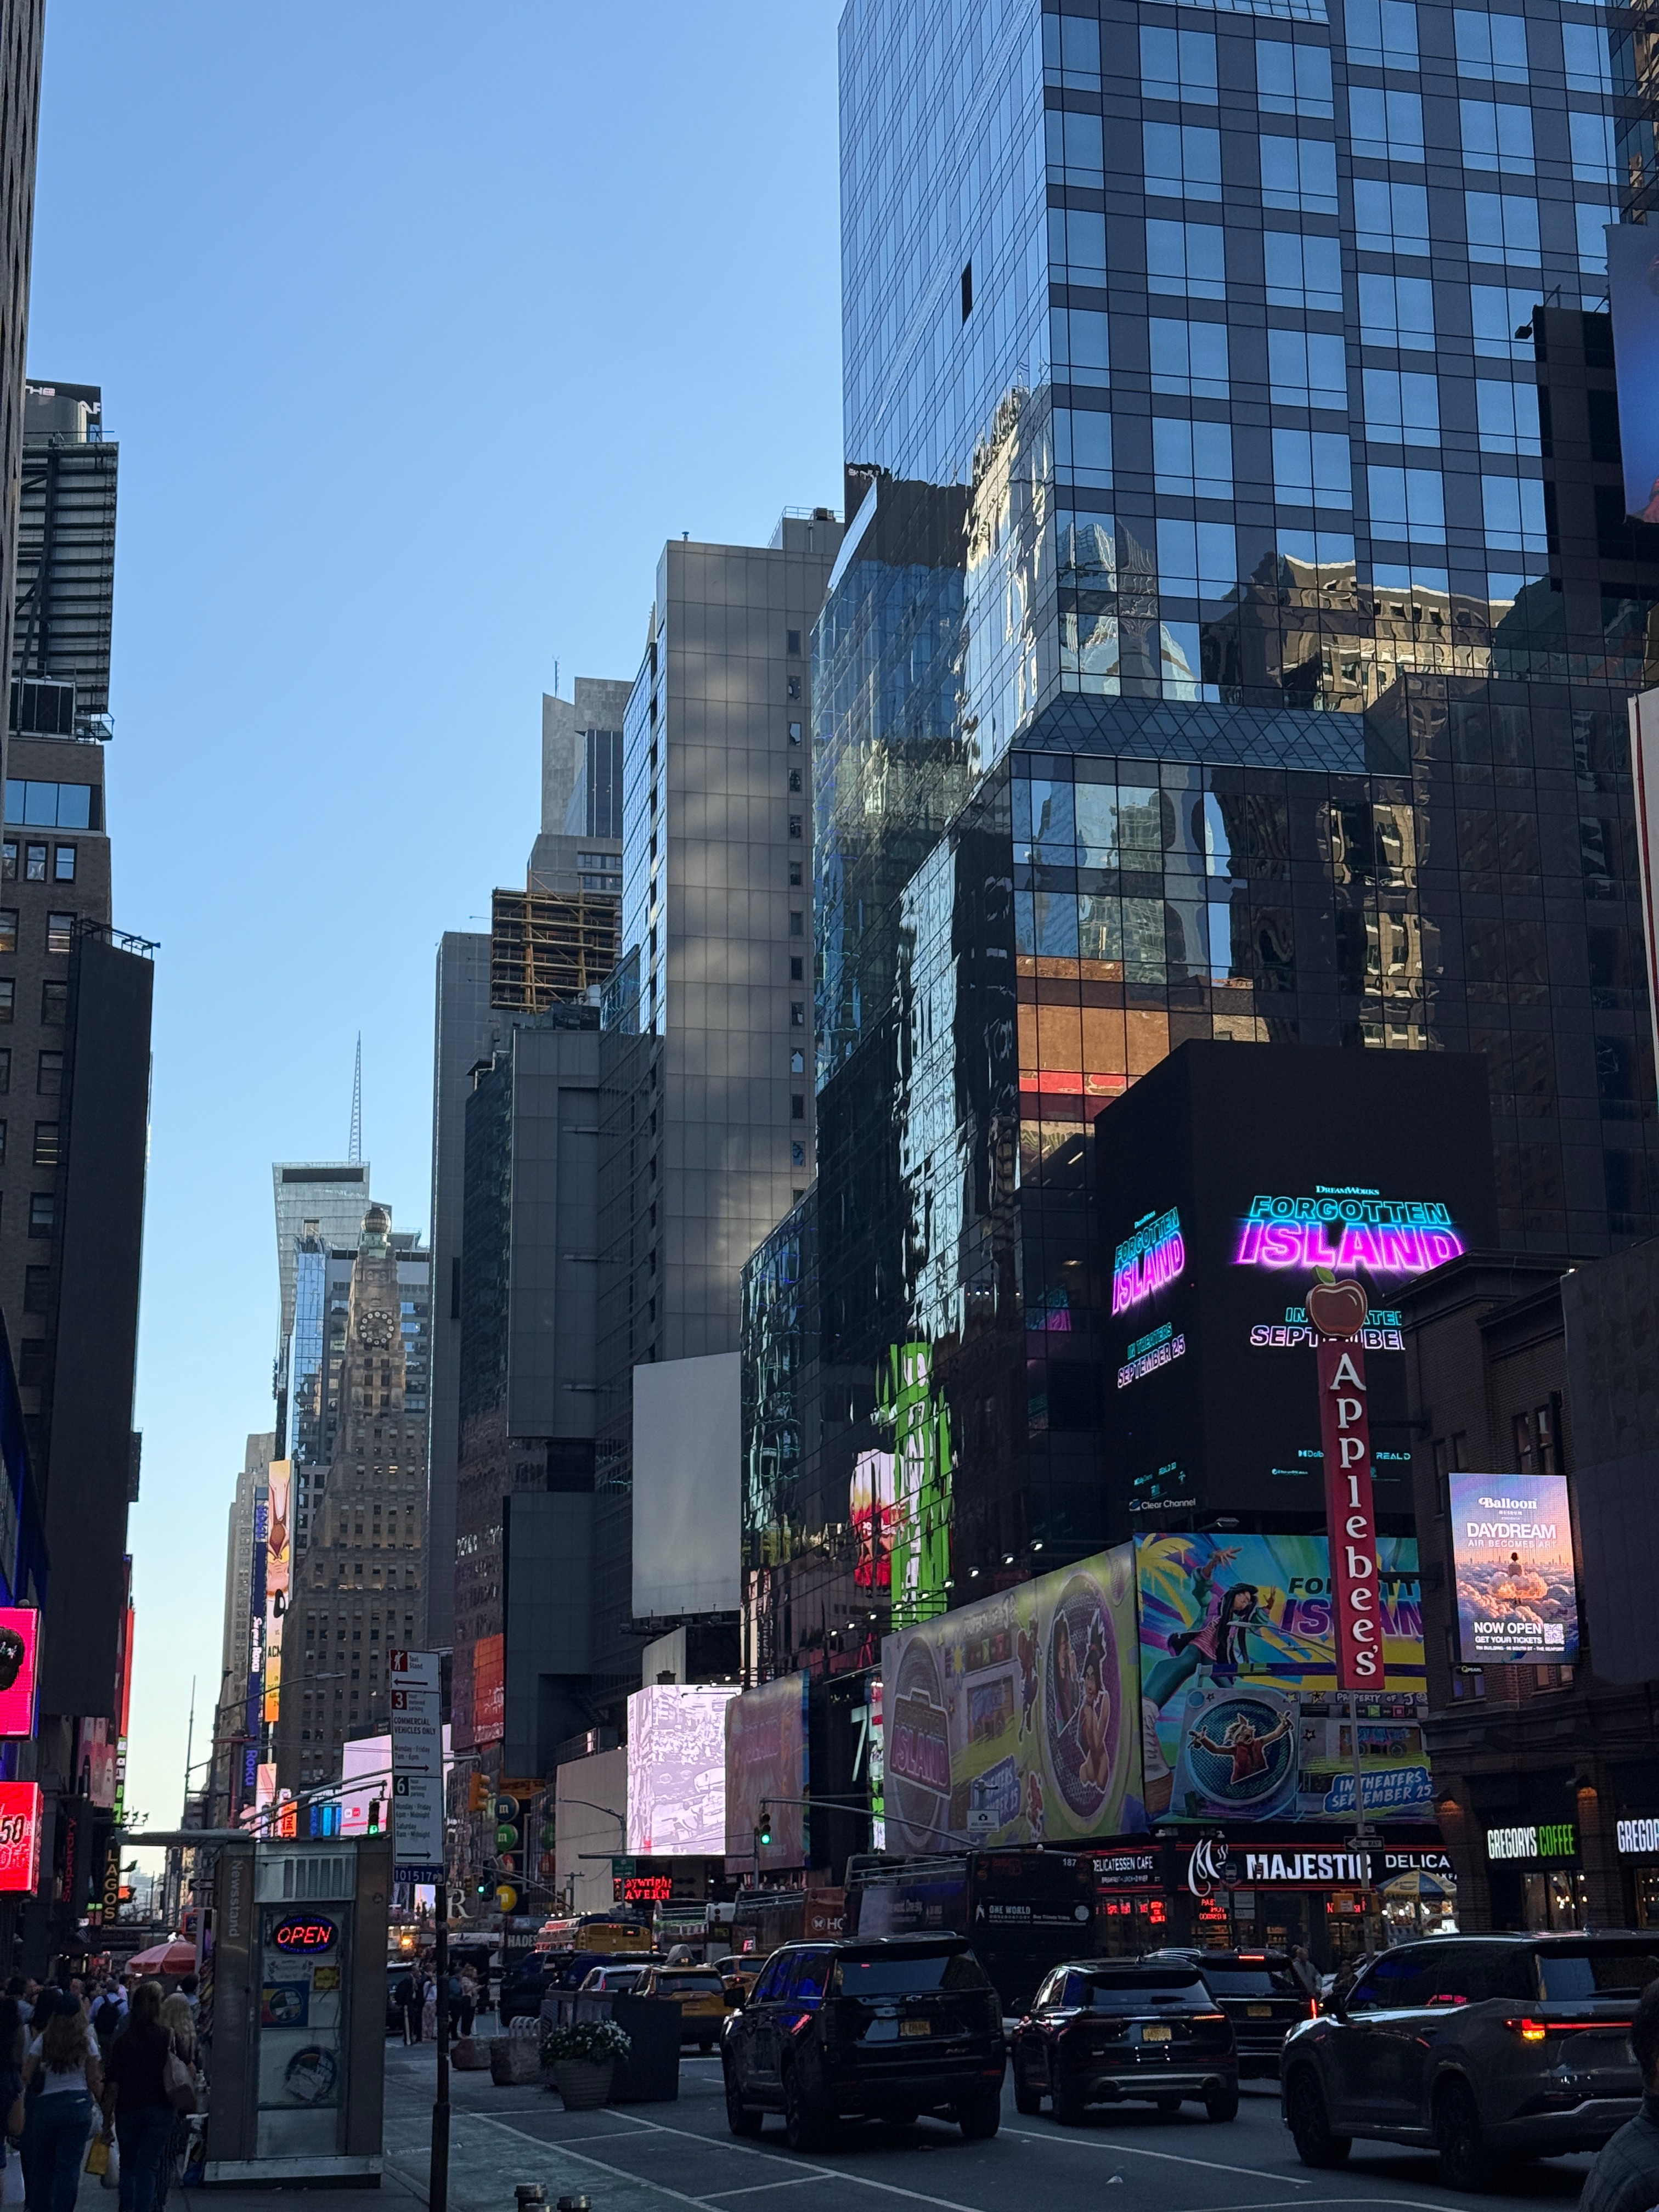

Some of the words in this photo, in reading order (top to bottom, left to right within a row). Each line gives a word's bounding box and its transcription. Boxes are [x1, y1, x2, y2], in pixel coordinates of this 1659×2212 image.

[1250, 1196, 1452, 1224] FORGOTTEN
[1115, 1206, 1180, 1268] FORGOTTEN
[1237, 1219, 1464, 1269] ISLAND
[1111, 1231, 1185, 1316] ISLAND
[1136, 1322, 1172, 1355] THEATERS
[1250, 1325, 1405, 1350] SEPTBE
[1118, 1343, 1172, 1389] SEPTEMBER
[1172, 1333, 1186, 1359] 25
[1163, 1498, 1196, 1508] Channel
[1478, 1497, 1537, 1509] Balloon
[1329, 1353, 1379, 1675] Applebee's
[1466, 1522, 1556, 1539] DAYDREAM
[1488, 1539, 1534, 1549] BECOMES
[1474, 1622, 1504, 1634] NOW
[1507, 1623, 1542, 1634] OPEN
[1513, 1637, 1543, 1645] TICKETS
[395, 1692, 403, 1708] 3
[394, 1717, 430, 1725] COMMERCIAL
[397, 1778, 405, 1794] 6
[1340, 1780, 1355, 1793] IN
[1361, 1771, 1423, 1790] THEATERS
[1332, 1787, 1412, 1807] SEPEMBER
[1417, 1784, 1432, 1798] 25
[499, 1803, 509, 1814] m
[497, 1832, 507, 1842] m
[1487, 1826, 1537, 1859] GREGORYS
[1539, 1824, 1575, 1857] COFFEE
[1063, 1858, 1077, 1866] 187
[1137, 1855, 1154, 1870] CAFE
[1245, 1854, 1373, 1880] MAJESTIC
[1385, 1854, 1453, 1869] DELICA
[104, 1849, 119, 1920] LAGOS
[228, 1860, 244, 1937] Newsstand
[624, 1889, 670, 1900] AVERN
[989, 1905, 1003, 1914] ONE
[1005, 1905, 1031, 1915] WORLD
[277, 1926, 332, 1944] OPEN
